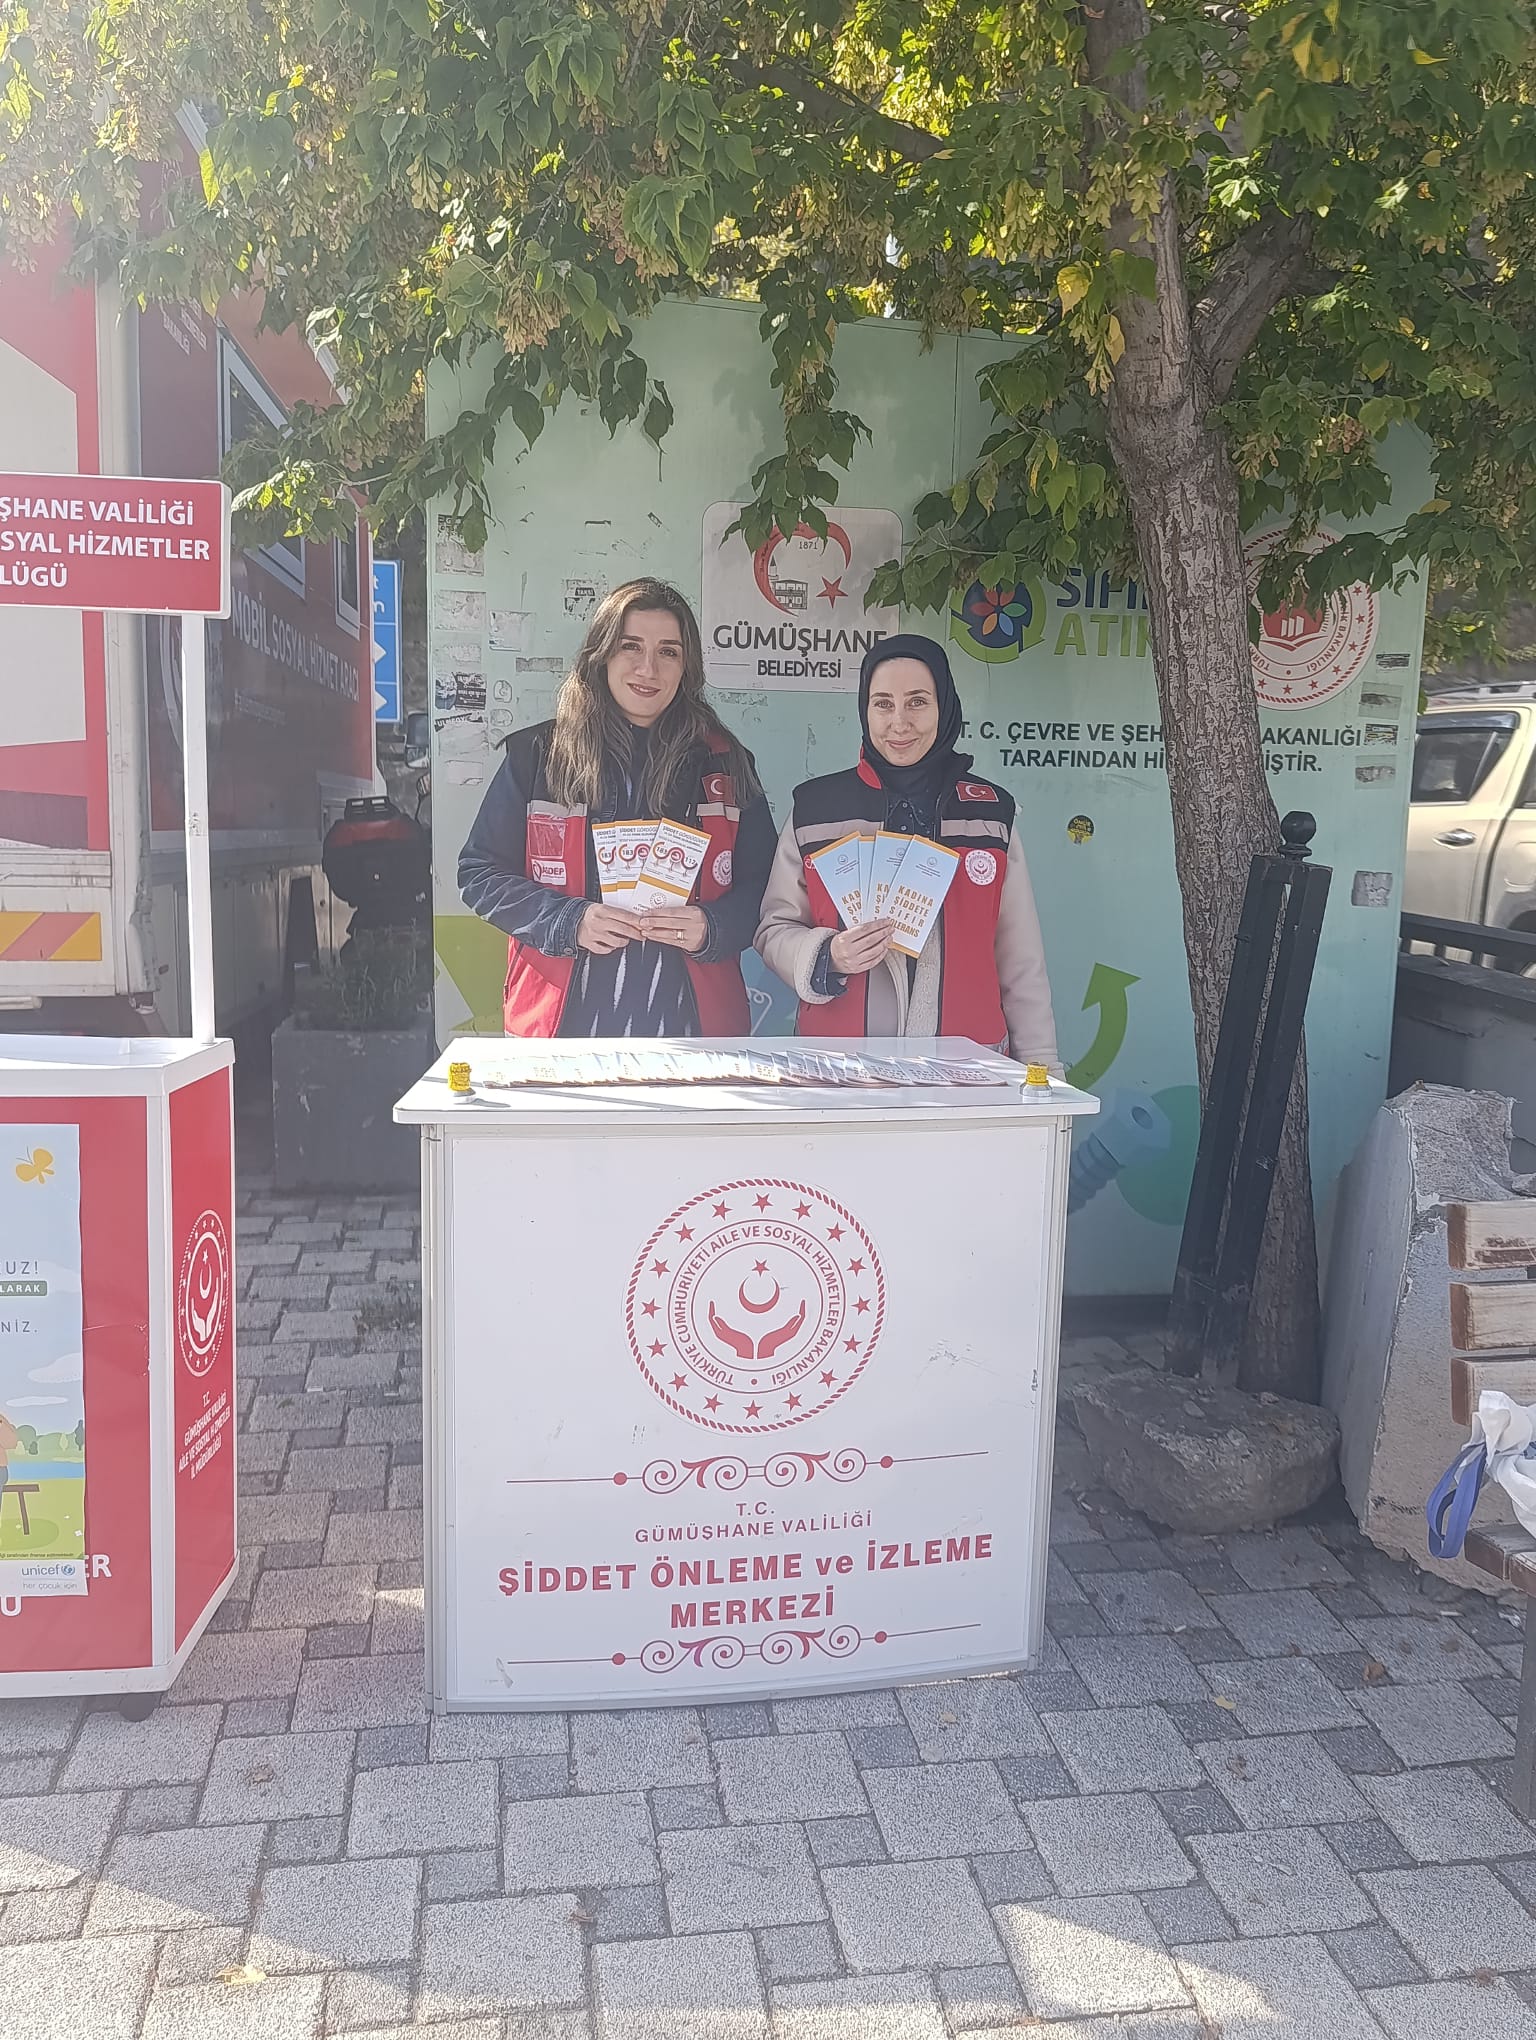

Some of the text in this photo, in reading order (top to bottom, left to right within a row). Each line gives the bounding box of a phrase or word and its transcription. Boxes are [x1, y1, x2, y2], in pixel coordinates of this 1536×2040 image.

[88, 498, 194, 525] VALİLİĞİ
[68, 530, 211, 560] HİZMETLER
[799, 541, 818, 550] 1871
[231, 585, 271, 656] MOBİL
[272, 614, 309, 677] SOSYAL
[310, 633, 339, 693] HİZMET
[757, 658, 842, 679] BELEDİYESİ
[979, 721, 1000, 740] C.
[1007, 722, 1080, 744] ÇEVRE
[1087, 723, 1115, 742] VE
[1121, 724, 1164, 745] ŞEH
[1262, 725, 1361, 746] AKANLIĞI
[1000, 749, 1137, 768] TARAFINDAN
[1264, 750, 1322, 775] İŞTİR.
[893, 895, 930, 917] ŞİDDETE
[898, 885, 934, 907] KADINA
[887, 916, 920, 937] OLERANS
[0, 1261, 39, 1275] UZ!
[673, 1225, 841, 1386] TÜRKİYE CUMHURİYETİ AİLE VE SOSYAL HİZMETLER BAKANLIĞI
[735, 1501, 775, 1517] T.C.
[635, 1510, 872, 1543] GÜMÜŞHANE VALİLİĞİ
[22, 1563, 60, 1576] unicef
[498, 1534, 993, 1596] ŞİDDET ÖNLEME ve İZLEME
[38, 1582, 60, 1590] çocuk
[64, 1582, 77, 1590] için
[670, 1584, 835, 1628] MERKEZİ
